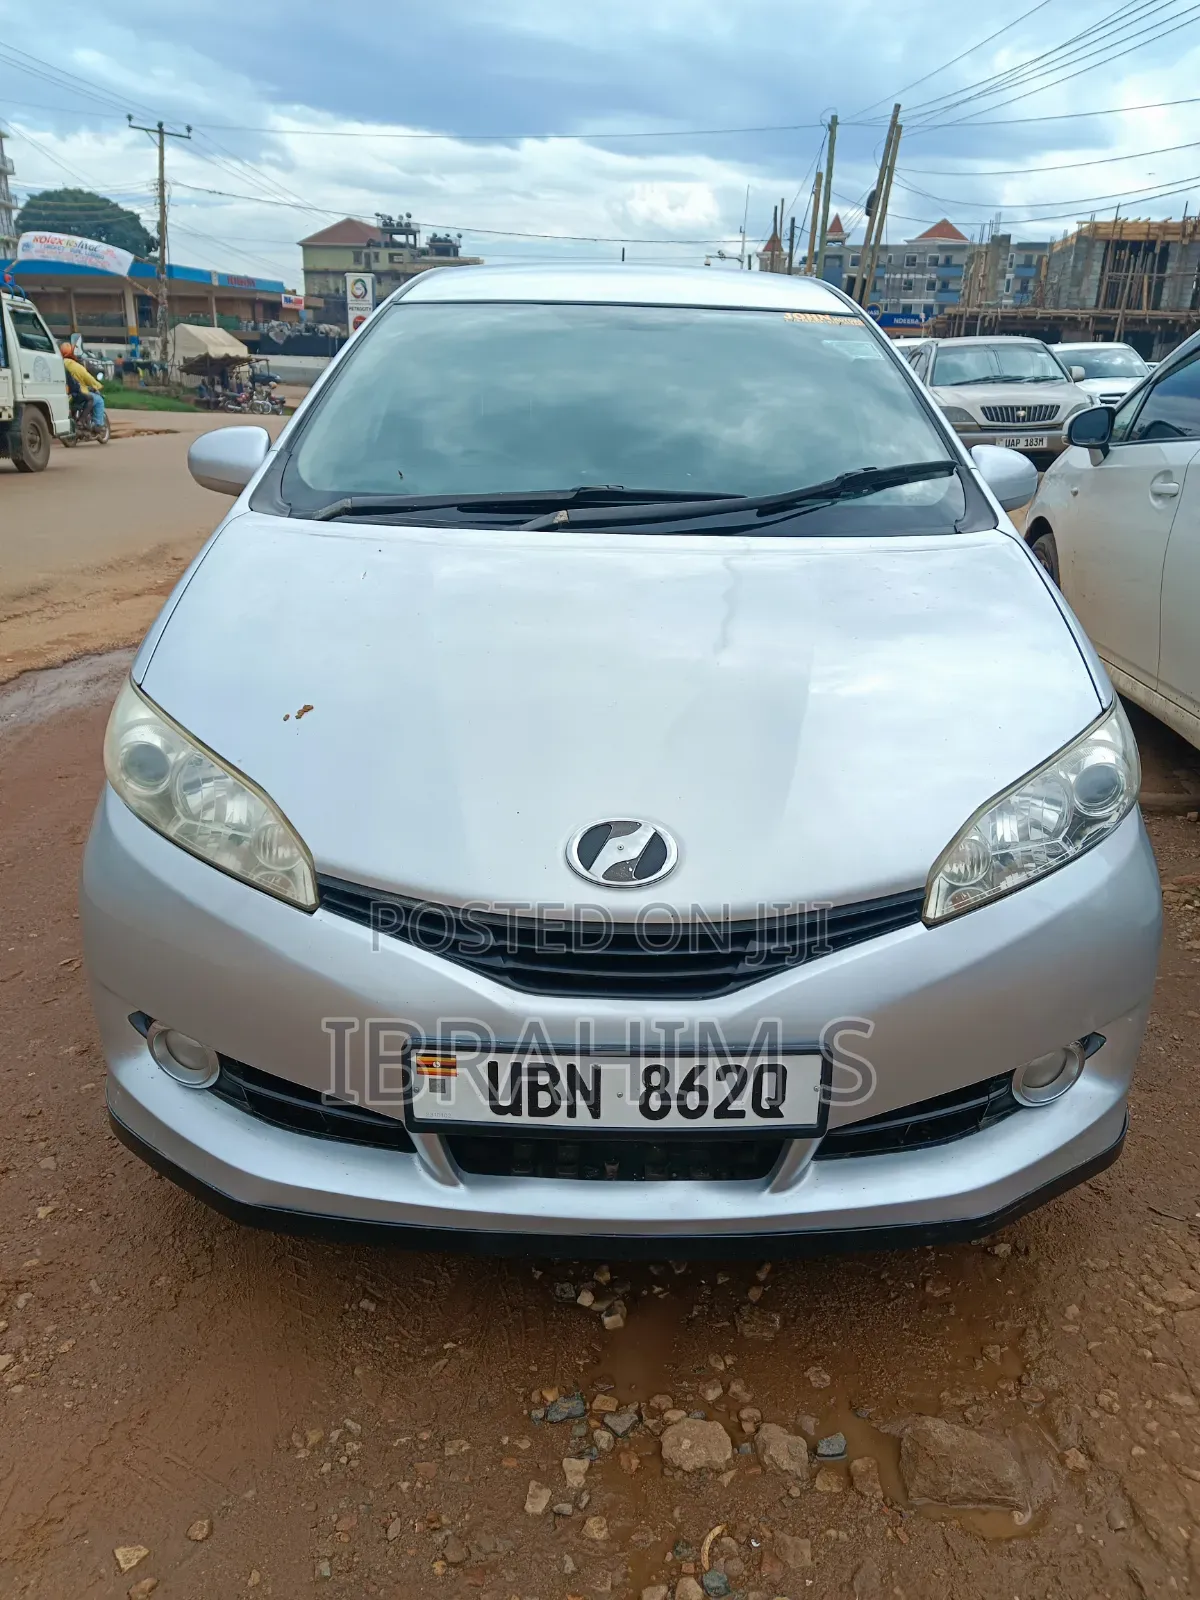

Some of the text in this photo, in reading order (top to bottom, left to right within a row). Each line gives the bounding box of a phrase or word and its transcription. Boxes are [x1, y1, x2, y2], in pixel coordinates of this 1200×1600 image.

[893, 317, 919, 325] NDEEBA
[1005, 438, 1021, 448] UAP
[487, 1060, 788, 1121] UBN 862Q
